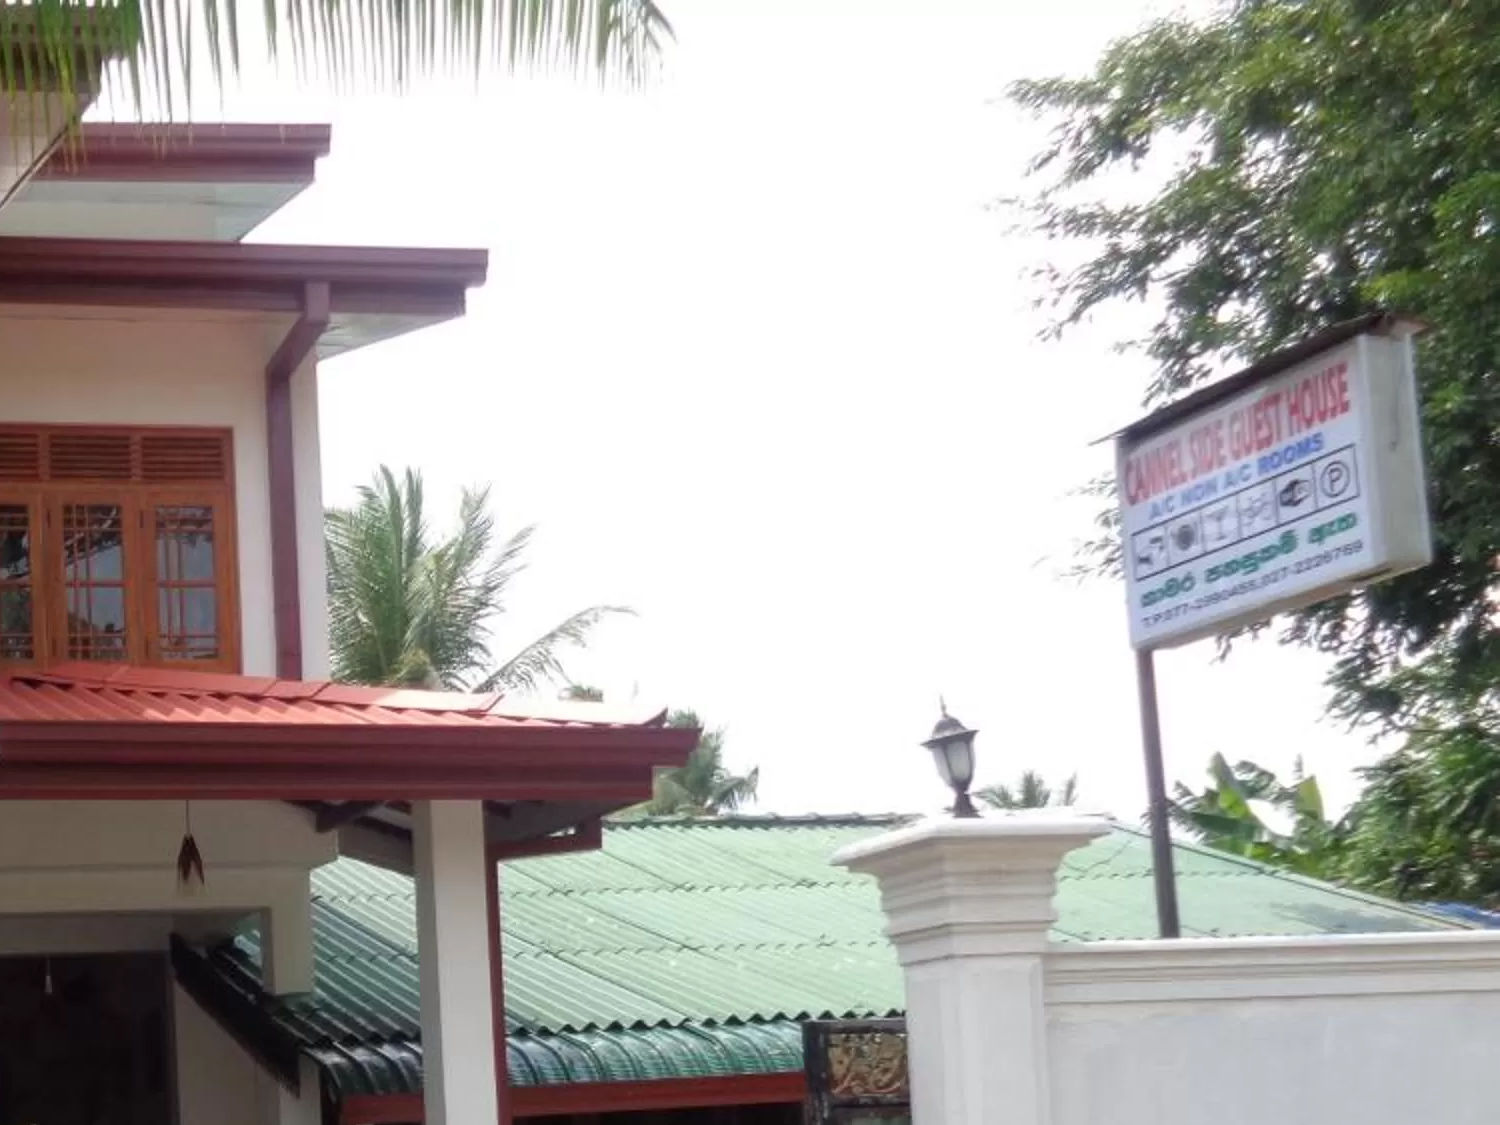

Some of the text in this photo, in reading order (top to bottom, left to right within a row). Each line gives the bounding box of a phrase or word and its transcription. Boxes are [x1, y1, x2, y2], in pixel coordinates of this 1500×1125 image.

[1189, 419, 1226, 478] SIDE
[1229, 391, 1282, 461] GUEST
[1287, 362, 1351, 436] HOUSE
[1257, 432, 1325, 477] ROOMS
